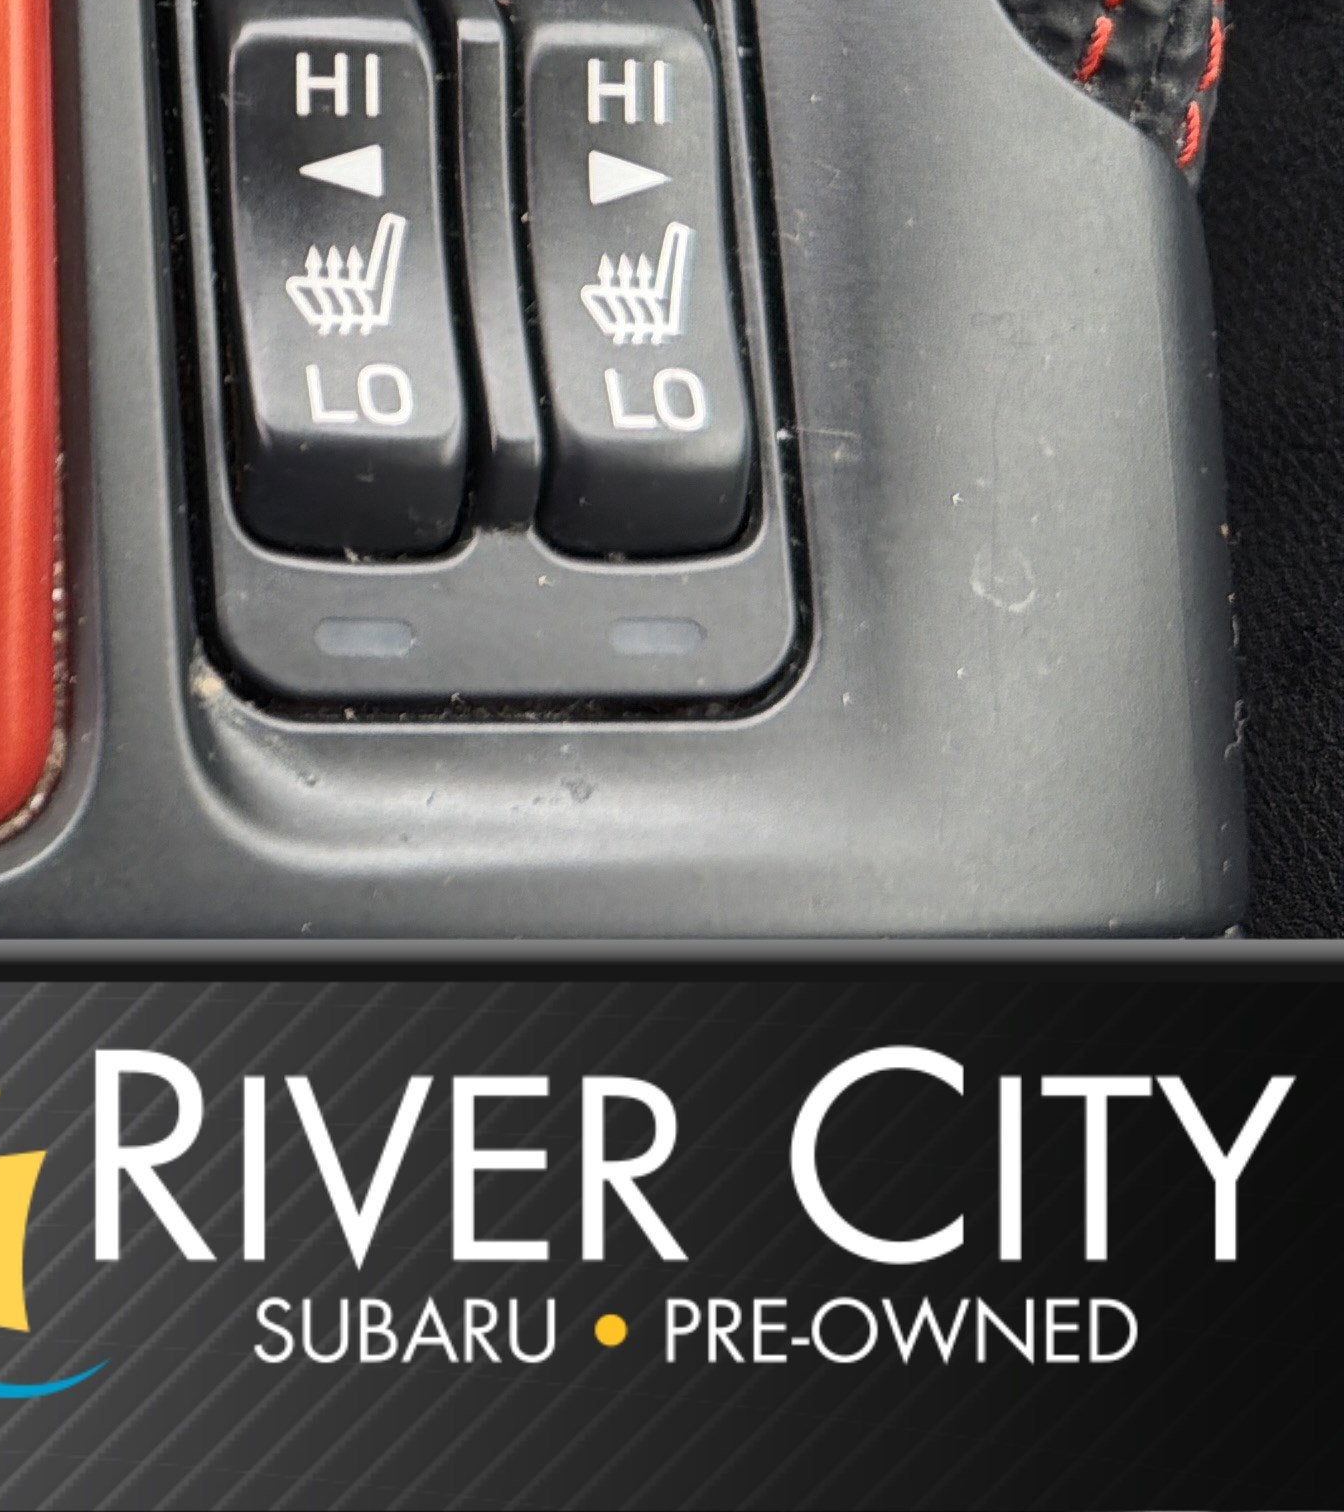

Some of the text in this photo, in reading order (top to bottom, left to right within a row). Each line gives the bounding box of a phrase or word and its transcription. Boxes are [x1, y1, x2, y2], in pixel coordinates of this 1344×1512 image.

[295, 52, 381, 117] HI
[587, 59, 672, 125] HI
[306, 364, 414, 426] LO
[604, 368, 708, 432] LO
